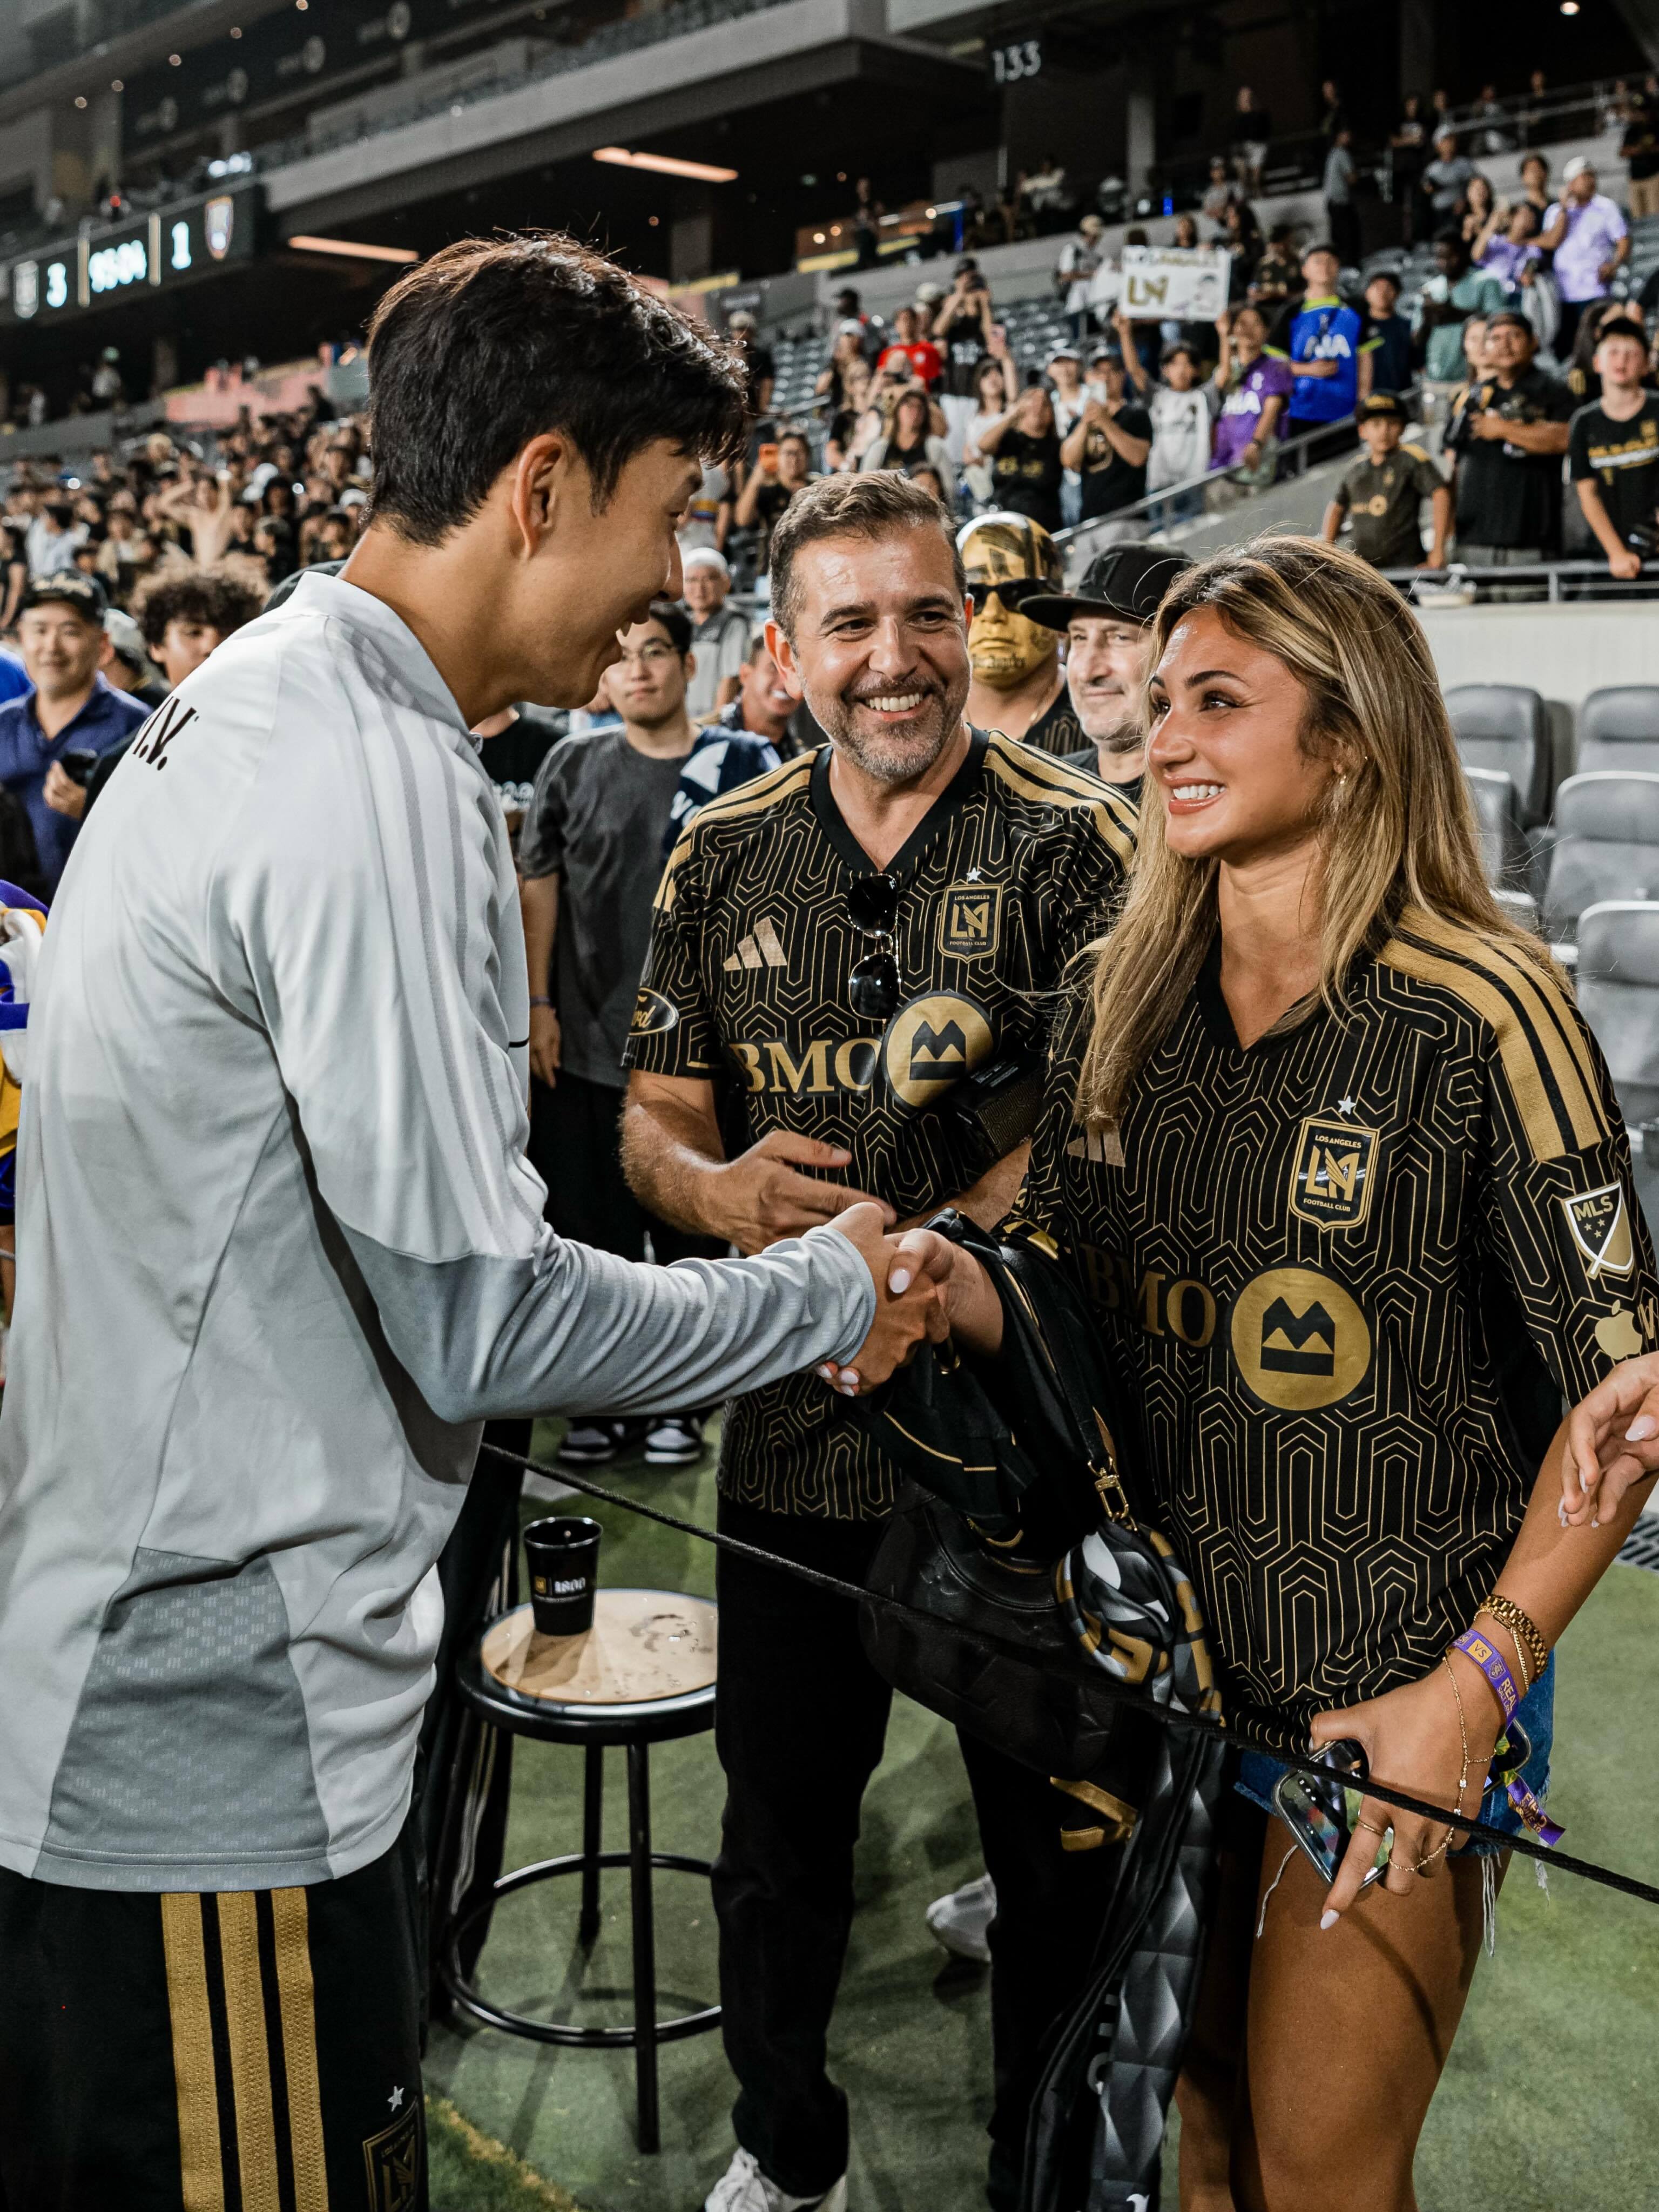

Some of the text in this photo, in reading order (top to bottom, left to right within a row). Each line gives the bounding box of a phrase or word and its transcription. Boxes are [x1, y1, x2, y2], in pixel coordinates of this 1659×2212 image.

[992, 40, 1042, 83] 133
[171, 221, 191, 269] 1
[729, 1038, 882, 1094] BMO
[1314, 1135, 1361, 1149] LOS ANGELES
[1303, 1198, 1351, 1212] FOOTBALL CLUB
[1573, 1195, 1614, 1222] MLS
[1474, 1643, 1487, 1658] VS
[1501, 1677, 1516, 1712] REAL
